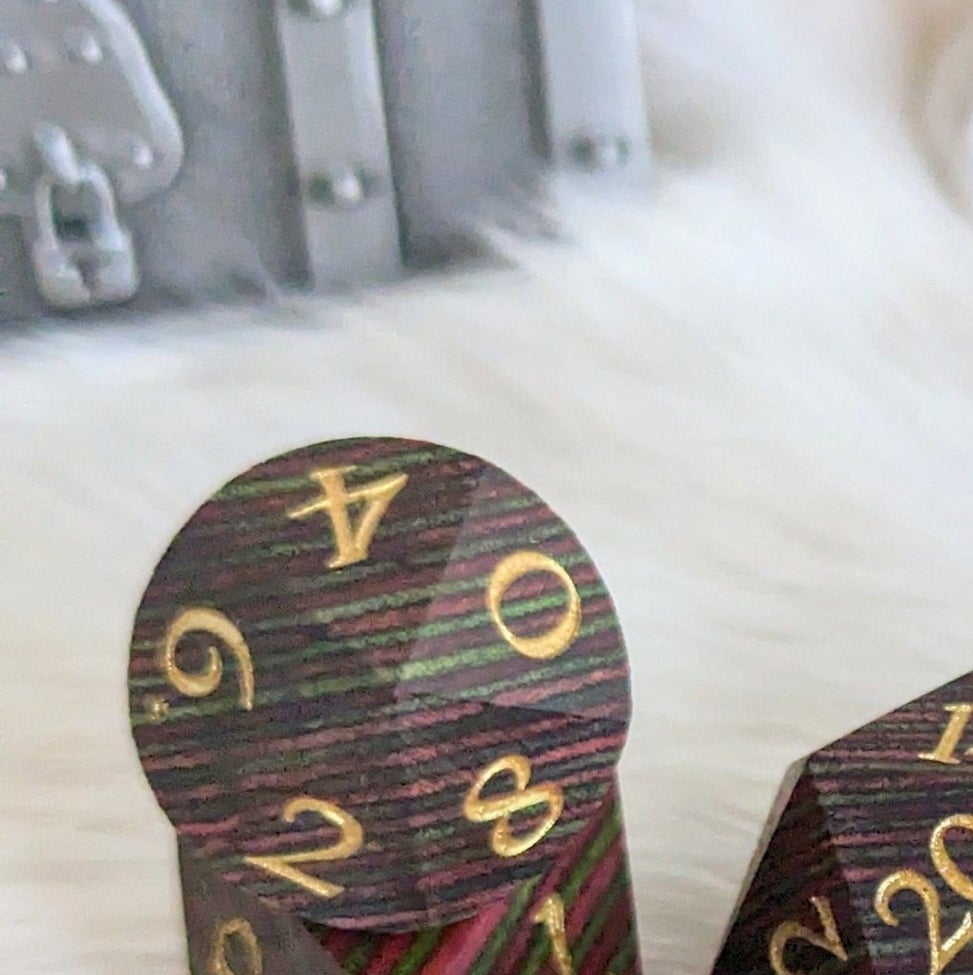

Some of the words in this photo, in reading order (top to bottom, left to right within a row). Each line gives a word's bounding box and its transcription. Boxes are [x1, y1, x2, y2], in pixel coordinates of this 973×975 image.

[289, 465, 408, 569] 4
[242, 796, 364, 898] 2
[464, 753, 564, 858] 8
